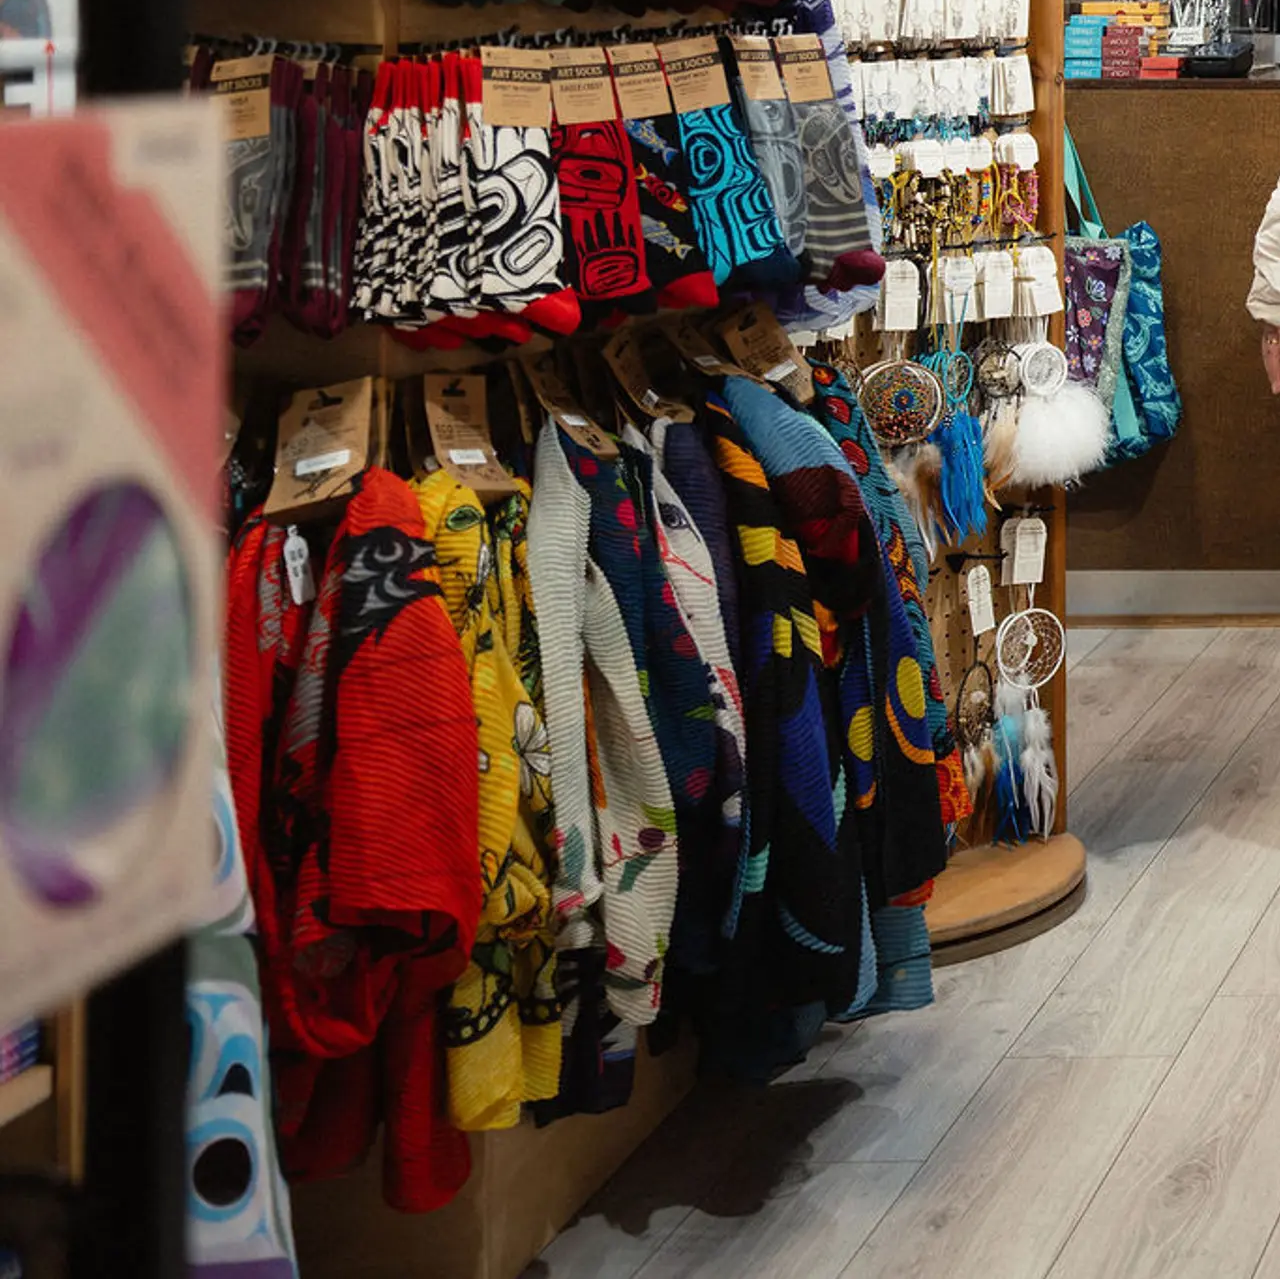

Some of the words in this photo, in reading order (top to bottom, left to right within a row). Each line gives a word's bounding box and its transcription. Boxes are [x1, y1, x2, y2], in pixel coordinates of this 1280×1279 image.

[618, 64, 632, 75] ART
[634, 62, 657, 72] SOCKS
[685, 55, 714, 69] SOCKS
[491, 68, 510, 81] ART
[512, 68, 544, 82] SOCKS
[557, 66, 574, 78] ART
[575, 65, 603, 77] SOCKS
